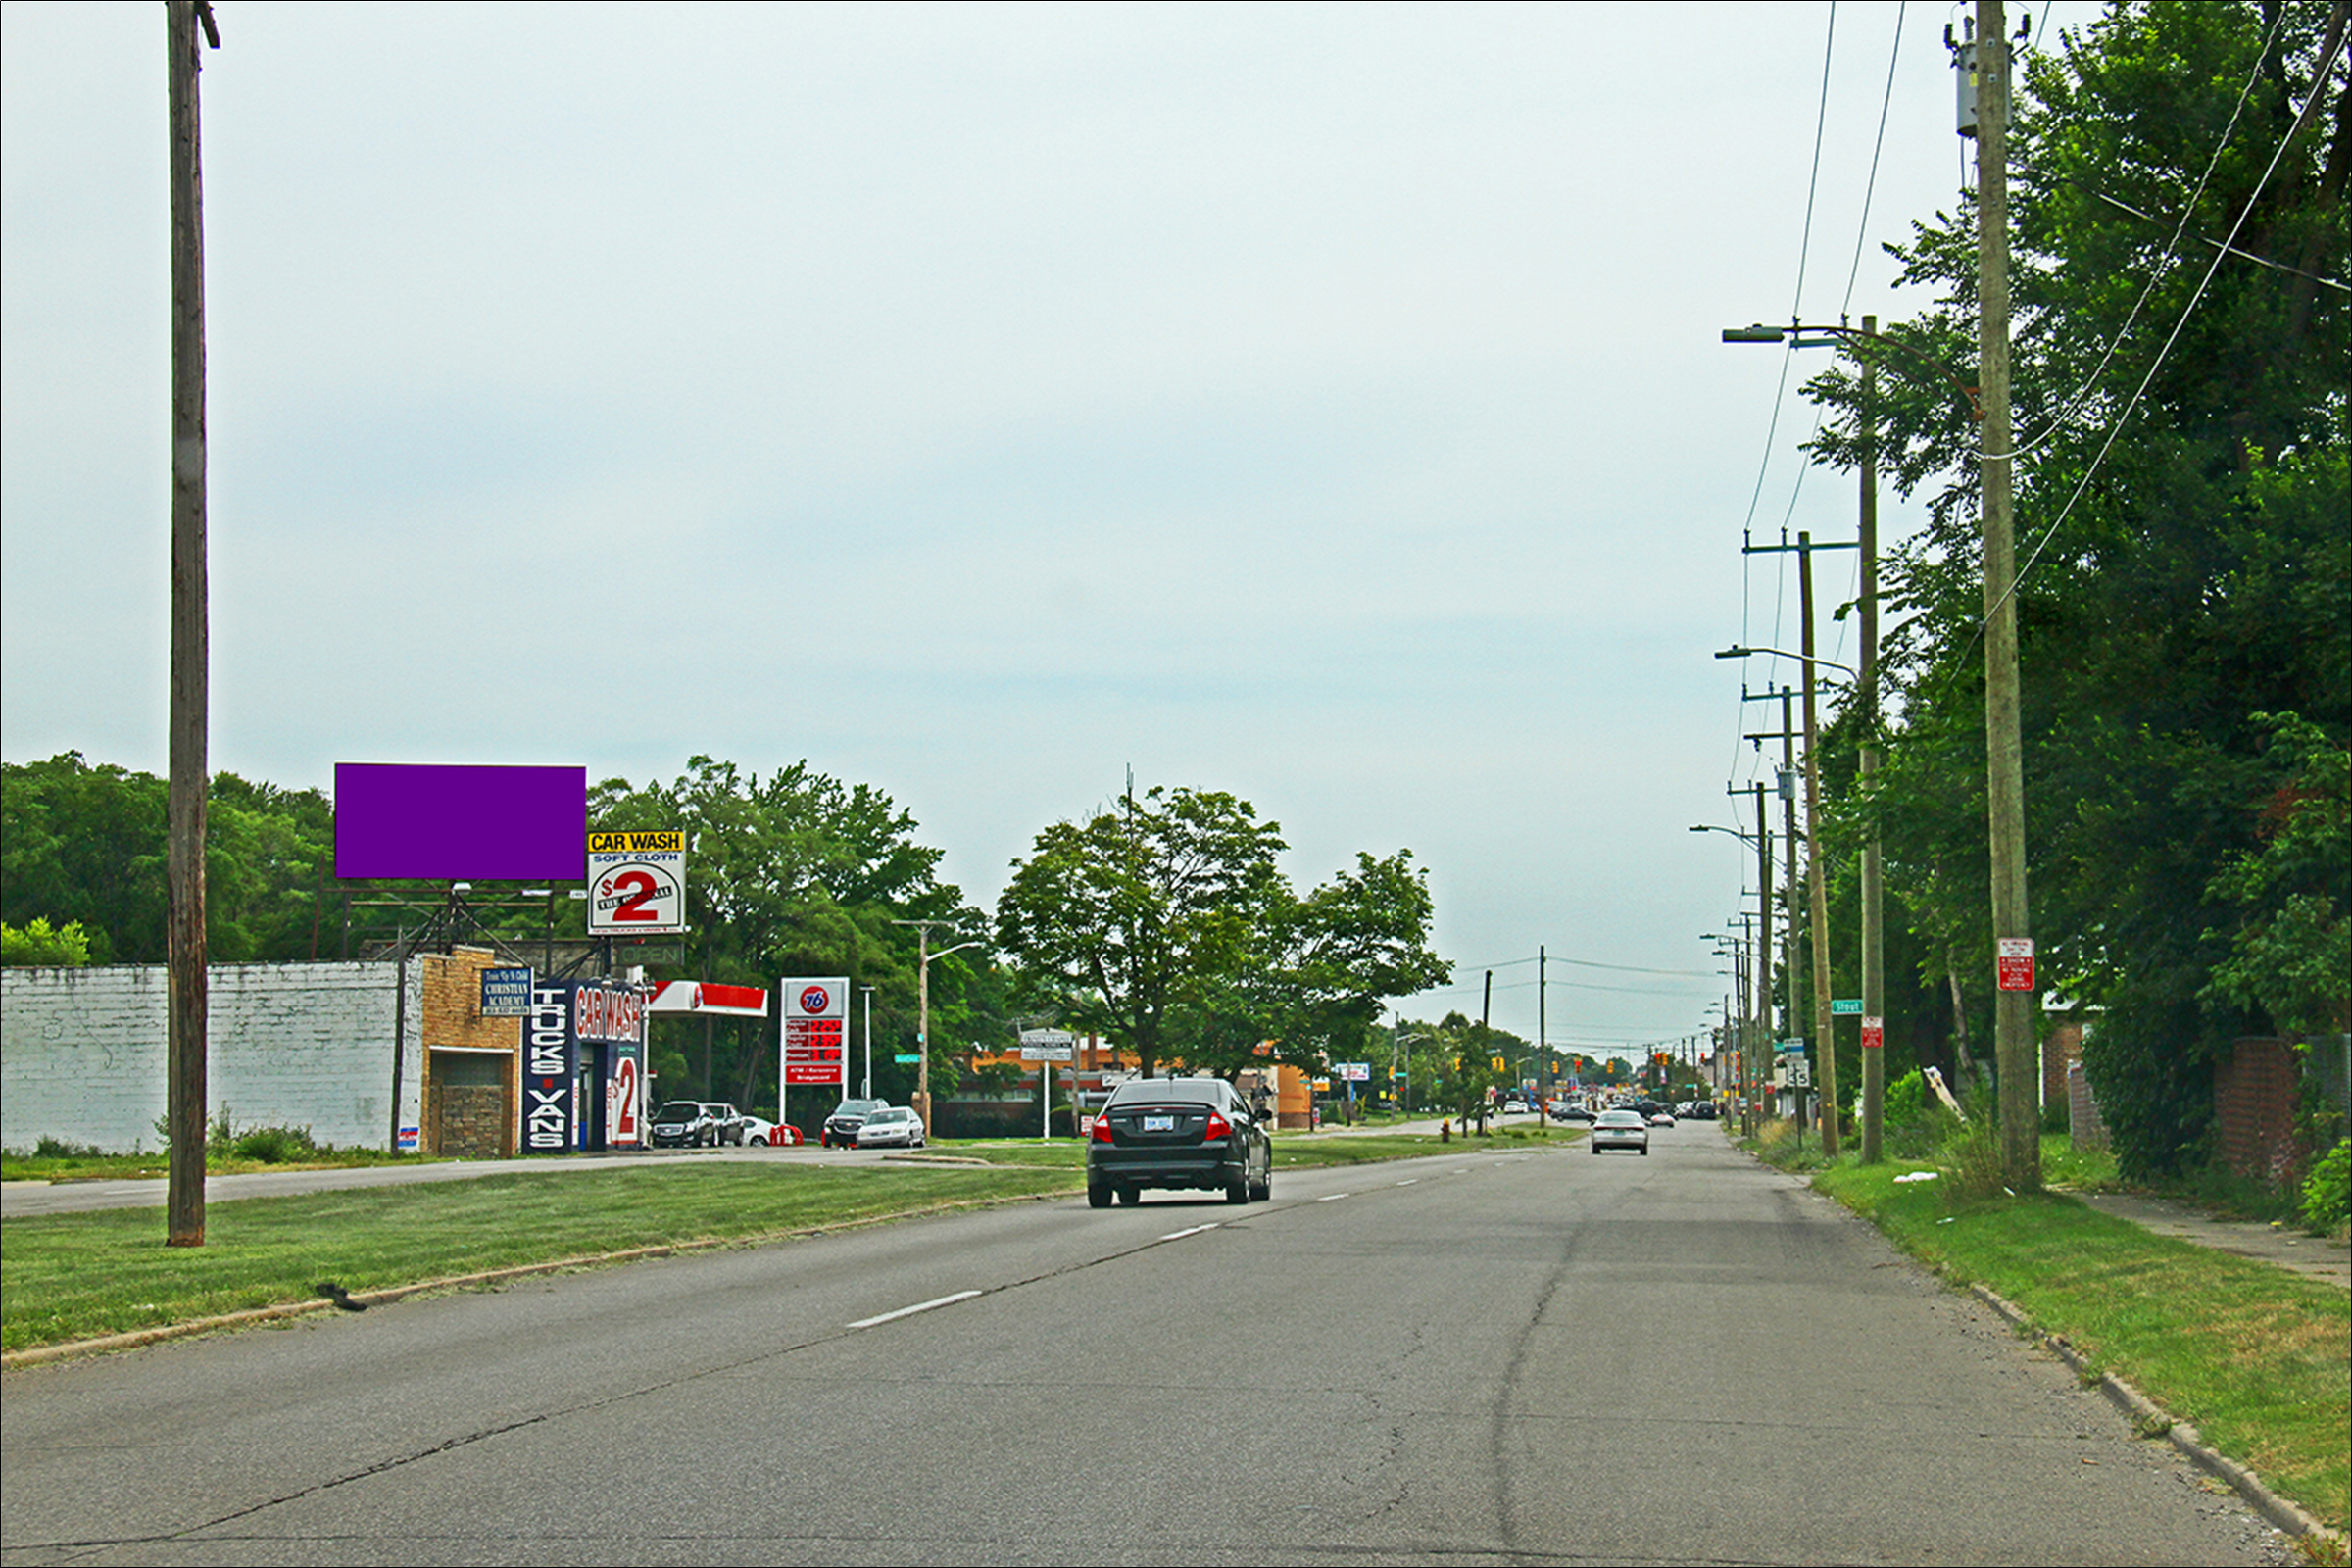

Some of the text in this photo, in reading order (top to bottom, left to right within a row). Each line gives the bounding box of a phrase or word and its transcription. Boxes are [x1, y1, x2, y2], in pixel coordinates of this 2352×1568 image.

[591, 833, 680, 851] CAR WASH
[598, 896, 621, 910] THE
[601, 870, 658, 921] $2
[622, 947, 677, 963] OPEN
[485, 983, 528, 995] CHRISTIAN
[489, 996, 525, 1006] ACADEMY
[804, 991, 825, 1009] 76
[1836, 1003, 1859, 1011] Stout
[575, 985, 604, 1040] CAR
[604, 989, 640, 1042] WASH
[531, 989, 566, 1075] TRUCKS
[527, 1089, 567, 1148] VANS
